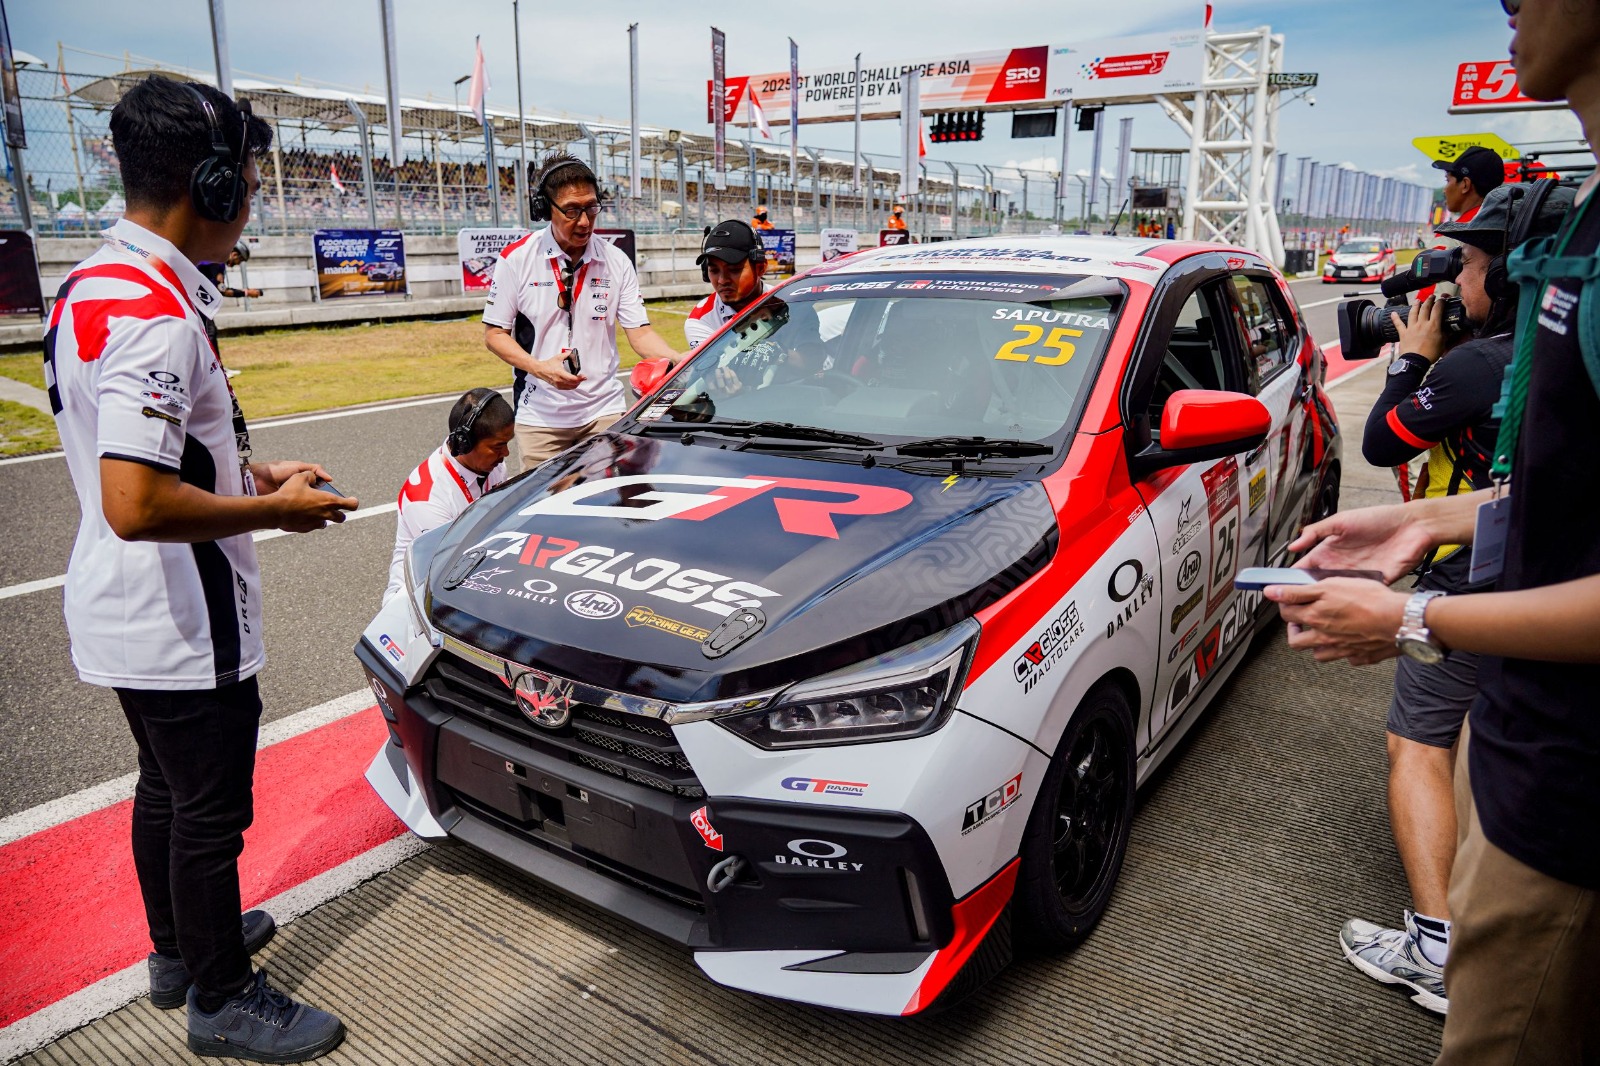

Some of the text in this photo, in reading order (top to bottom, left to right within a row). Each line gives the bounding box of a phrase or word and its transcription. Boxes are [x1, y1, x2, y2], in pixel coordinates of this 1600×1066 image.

[762, 79, 791, 93] 2025
[814, 71, 856, 87] WORLD
[937, 60, 971, 76] ASIA
[1005, 66, 1041, 81] SRO
[1460, 64, 1479, 100] AMAC
[1477, 62, 1529, 101] 5
[867, 83, 885, 97] BY
[790, 280, 896, 296] CARGLOSS
[987, 281, 1040, 289] GAZOO
[992, 308, 1110, 330] SAPUTRA
[994, 324, 1084, 367] 25
[518, 474, 913, 540] GR
[1213, 516, 1236, 588] 25
[463, 531, 783, 617] CARGLOSS
[1182, 558, 1199, 582] Arai
[506, 588, 557, 606] OAKLEY
[568, 593, 617, 613] Arai
[1106, 576, 1154, 639] OAKLEY
[647, 616, 708, 640] PRIME GEAR
[1013, 600, 1080, 683] CARGLOSS
[1038, 621, 1086, 680] AUTOCARE
[826, 784, 864, 793] RADIAL
[967, 779, 1019, 823] TCD
[691, 811, 719, 841] TOW
[774, 855, 864, 872] OAKLEY
